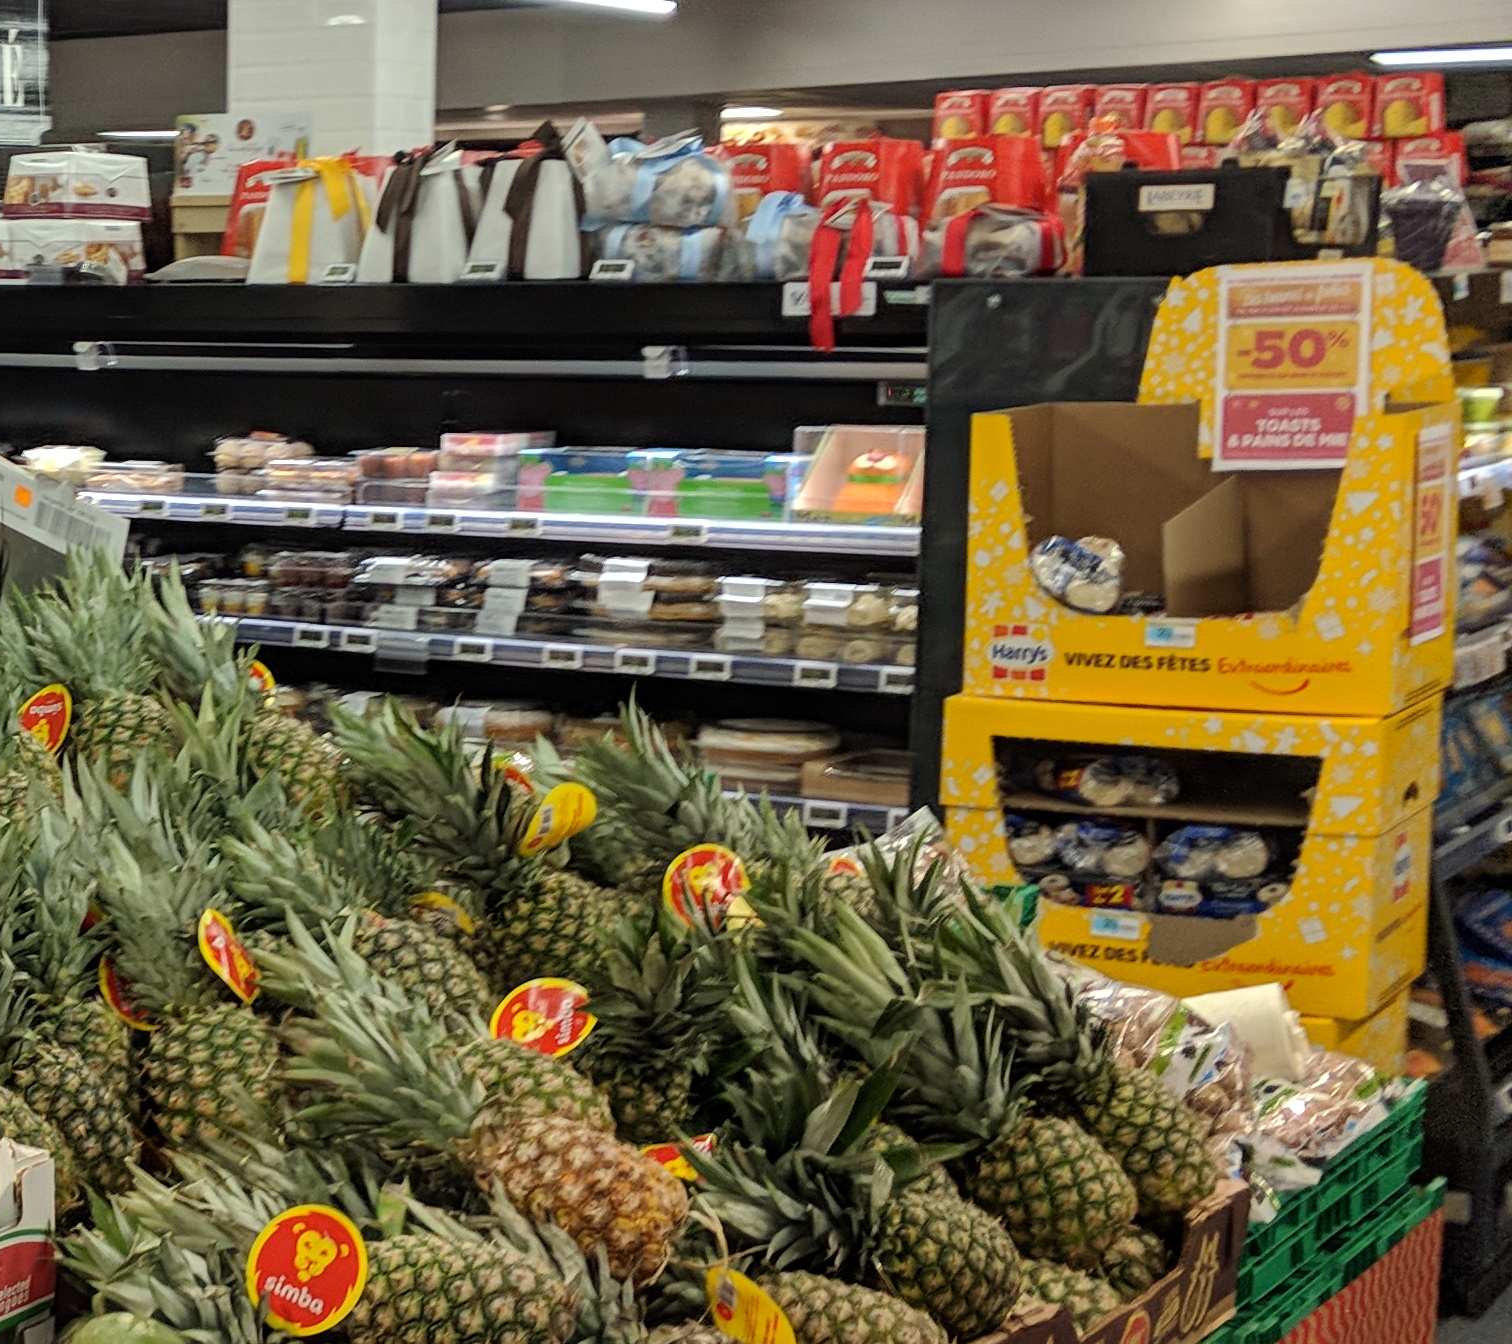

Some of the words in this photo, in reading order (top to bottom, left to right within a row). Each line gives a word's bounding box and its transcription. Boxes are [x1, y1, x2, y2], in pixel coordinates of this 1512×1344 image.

[1237, 328, 1349, 370] -50%
[1064, 652, 1116, 668] VIVEZ
[1120, 654, 1153, 670] DES
[1157, 653, 1211, 672] FÊTES
[263, 1275, 324, 1315] simba
